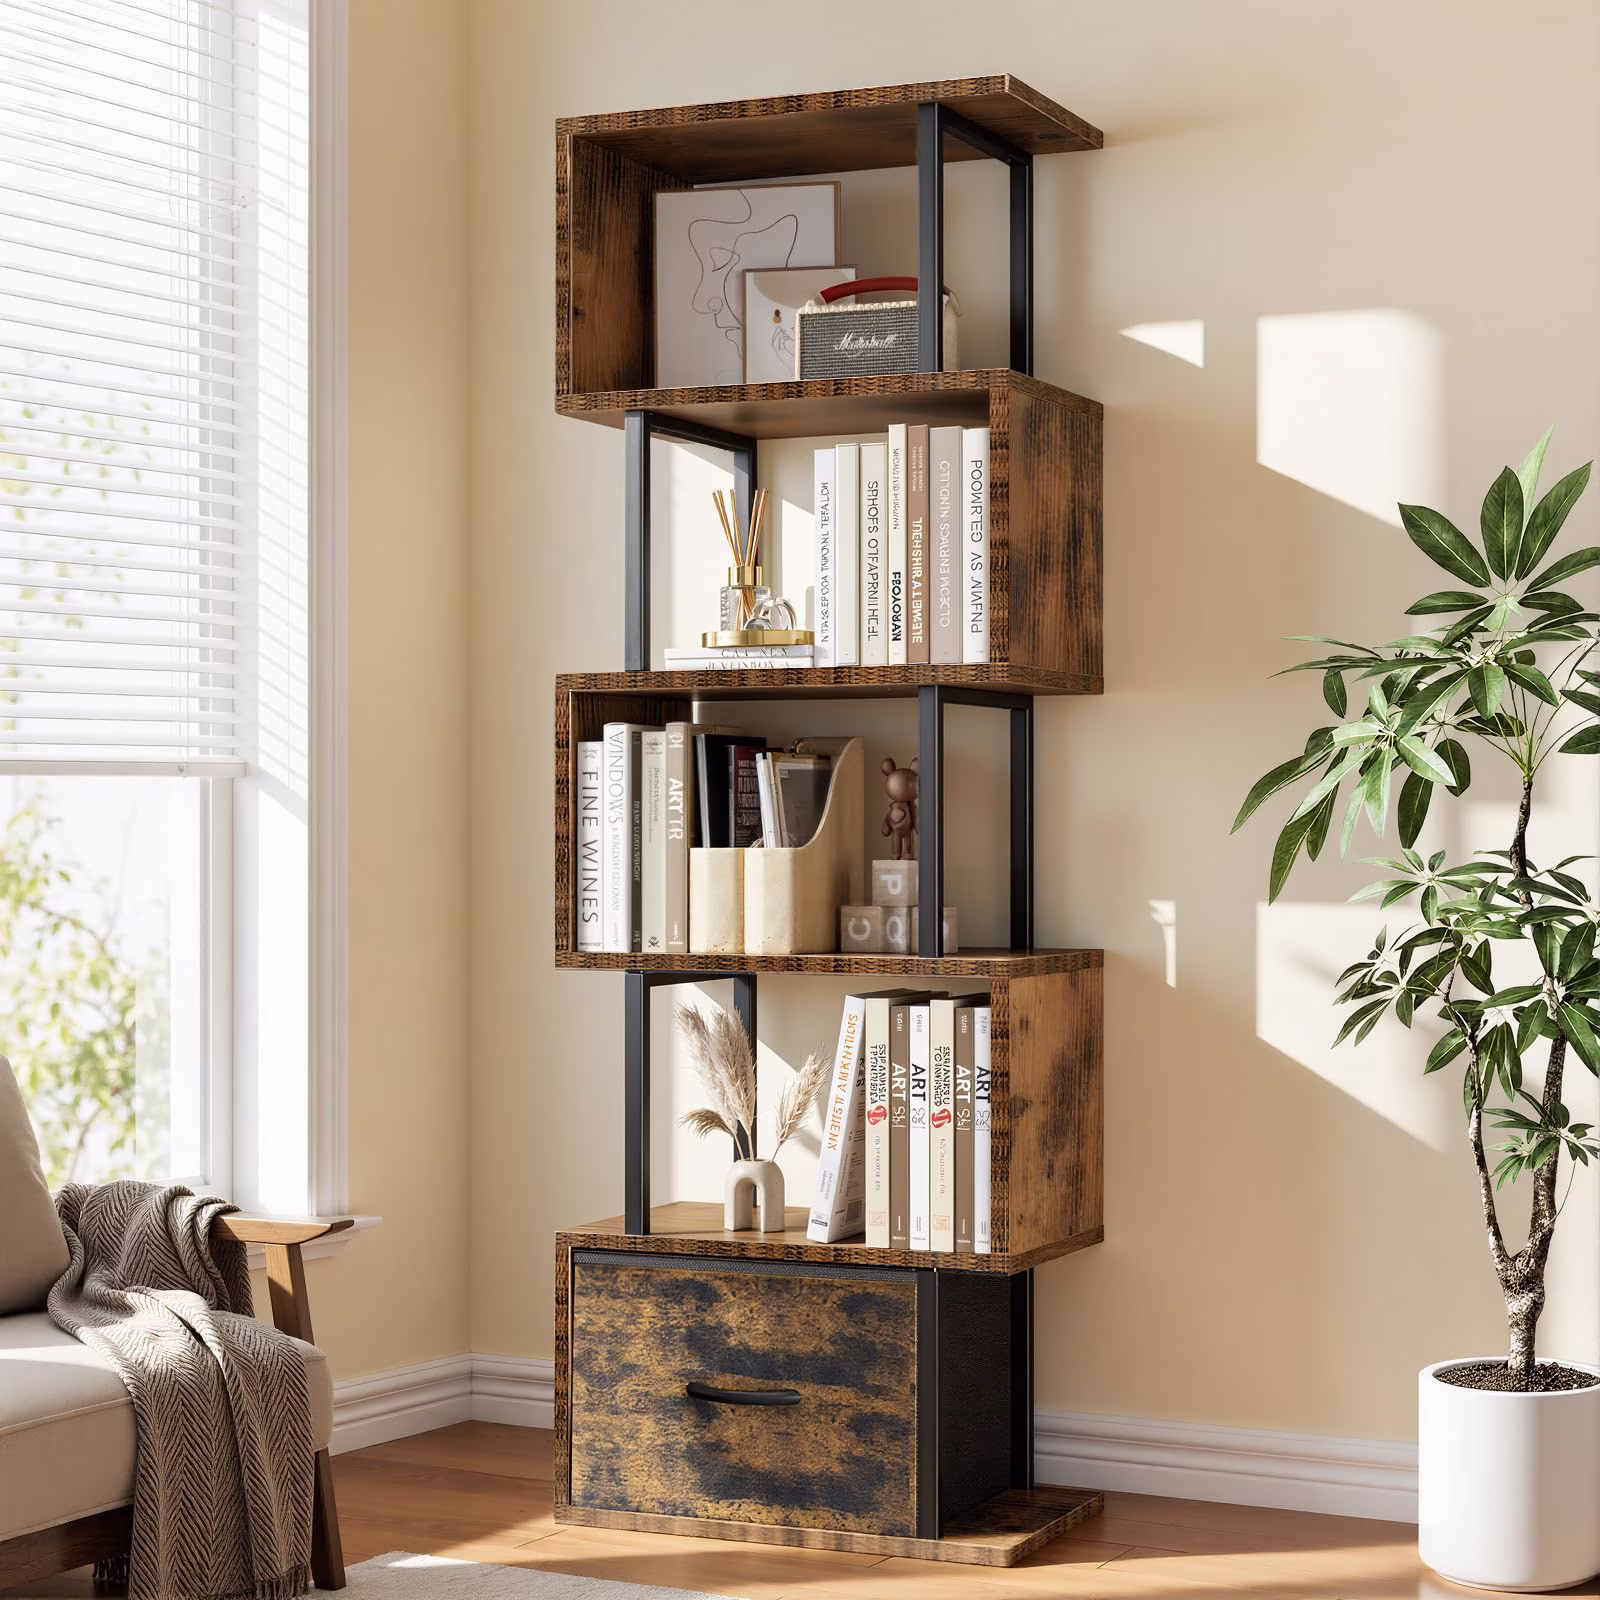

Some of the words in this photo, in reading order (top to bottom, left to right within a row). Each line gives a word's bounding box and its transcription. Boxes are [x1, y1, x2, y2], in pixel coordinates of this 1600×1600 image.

[582, 771, 598, 827] FINE
[582, 839, 598, 923] WINES
[880, 874, 902, 895] P
[848, 917, 871, 941] C
[891, 1063, 907, 1102] ART
[911, 1063, 926, 1102] ART
[956, 1064, 971, 1104] ART
[975, 1065, 991, 1104] ART
